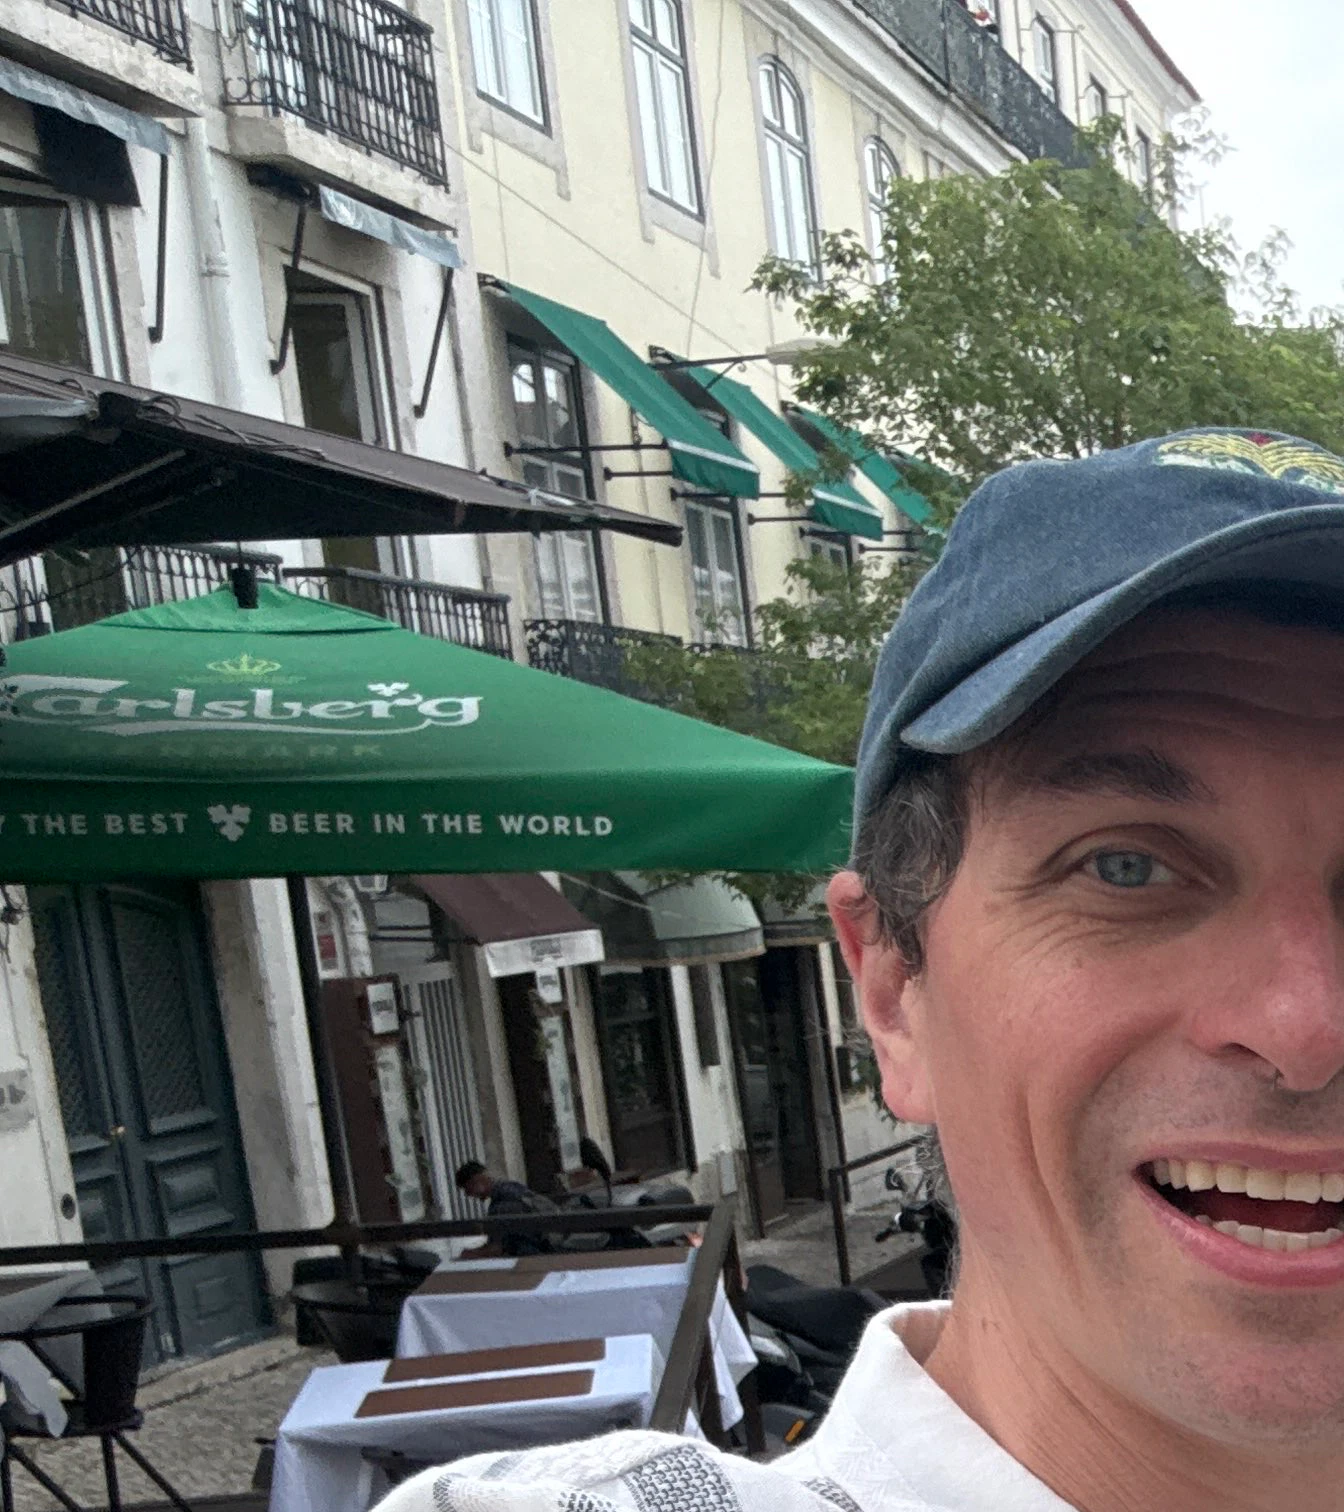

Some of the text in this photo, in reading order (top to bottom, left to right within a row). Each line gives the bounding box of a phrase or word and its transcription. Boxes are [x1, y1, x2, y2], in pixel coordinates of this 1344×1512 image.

[0, 673, 484, 737] Carlsberg
[19, 812, 89, 836] THE
[103, 812, 189, 836] BEST
[267, 812, 355, 835] BEER
[373, 812, 406, 835] IN
[420, 812, 483, 835] THE
[498, 814, 614, 837] WORLD
